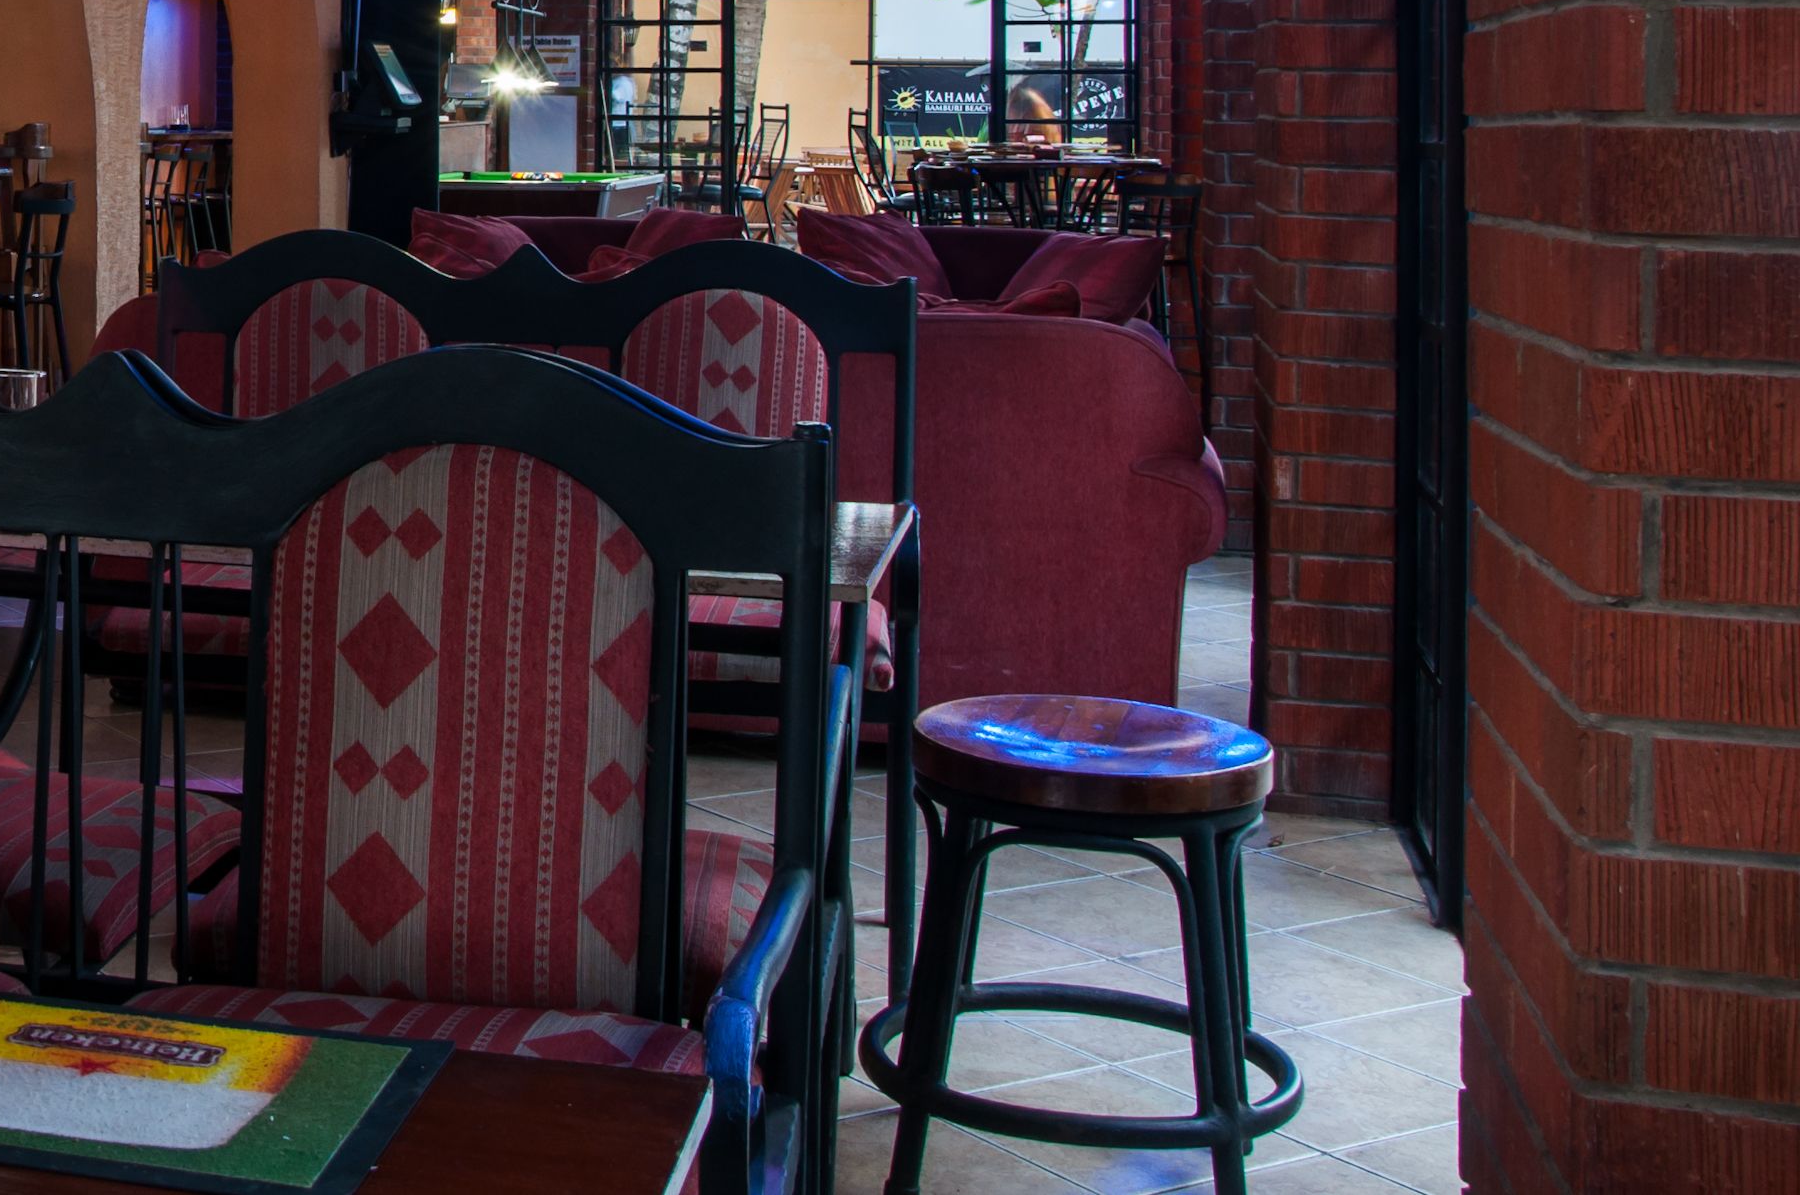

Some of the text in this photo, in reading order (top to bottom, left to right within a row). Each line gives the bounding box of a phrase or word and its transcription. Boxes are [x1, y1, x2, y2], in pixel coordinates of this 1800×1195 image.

[925, 90, 985, 103] KAHAMA
[925, 104, 991, 113] BAMBURI BEACH
[29, 1028, 206, 1062] Heineken
